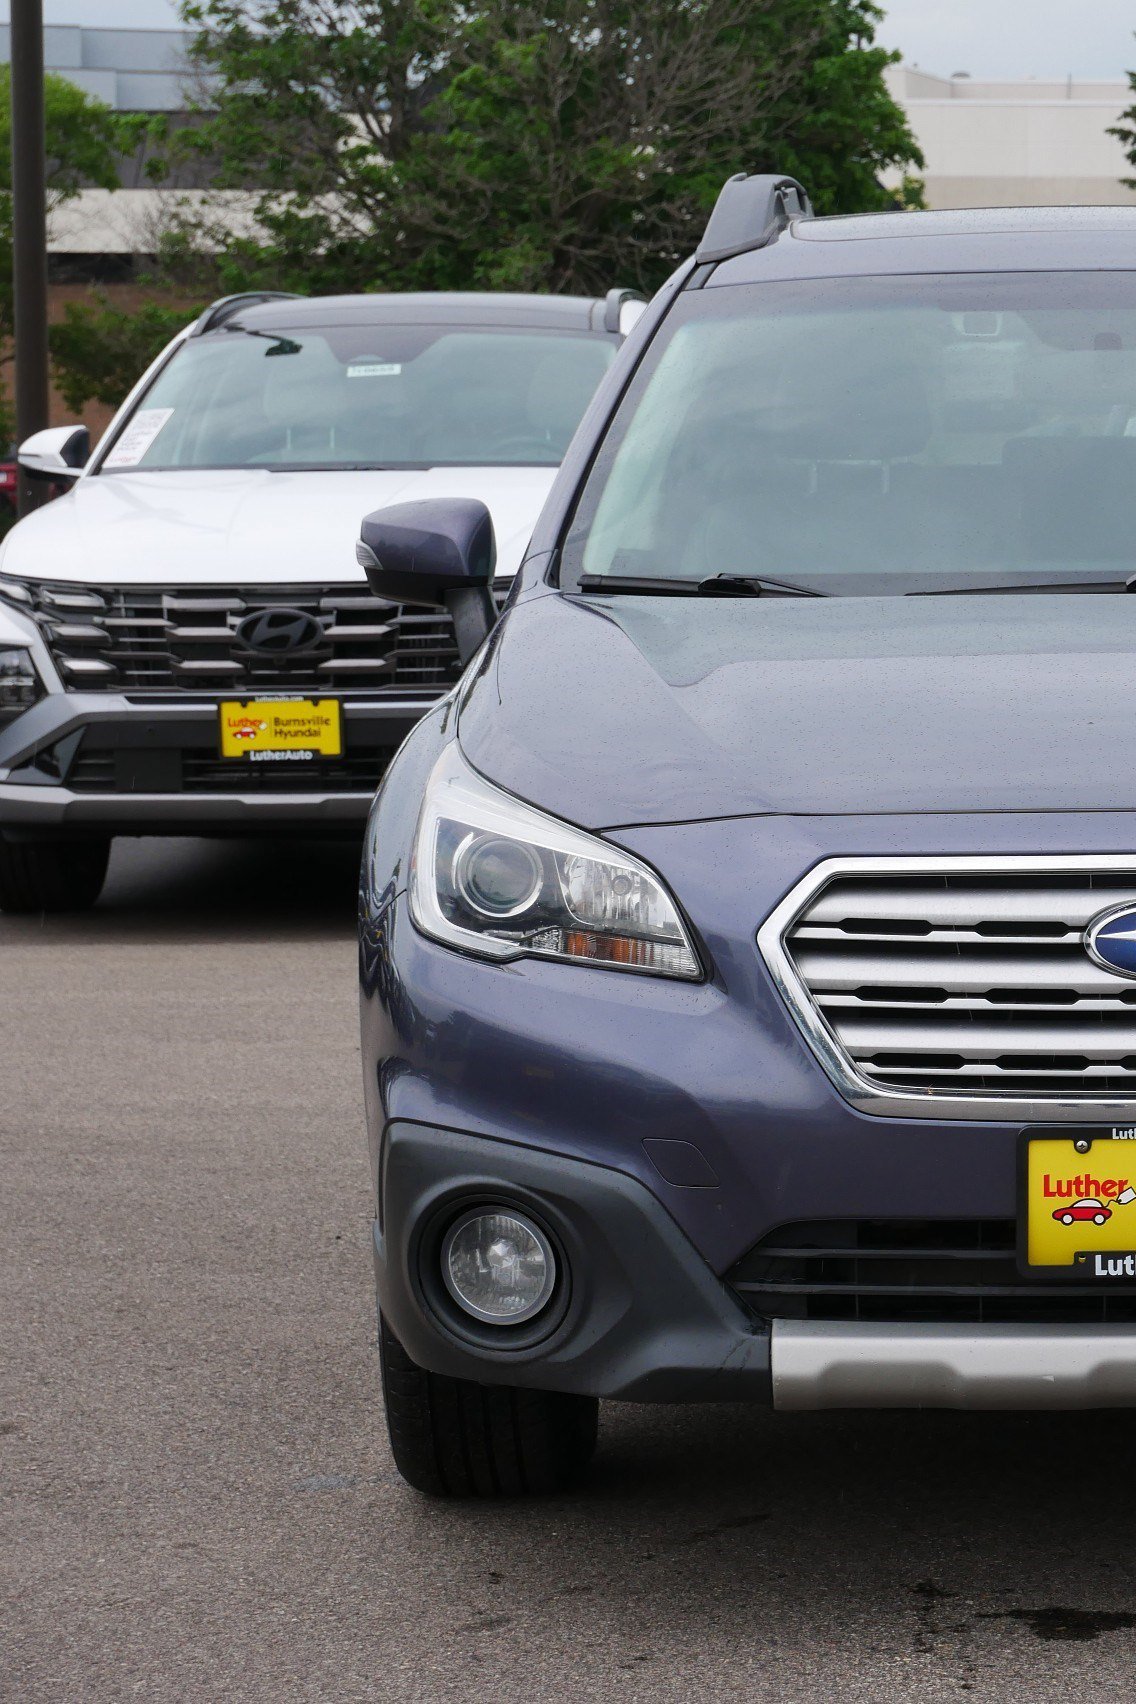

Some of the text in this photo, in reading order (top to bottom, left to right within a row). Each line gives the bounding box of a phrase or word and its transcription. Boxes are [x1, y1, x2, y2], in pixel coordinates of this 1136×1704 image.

[274, 716, 331, 726] Burnsville
[274, 728, 321, 739] Hyundai
[249, 750, 313, 761] LutherAuto
[1043, 1174, 1129, 1198] Luther
